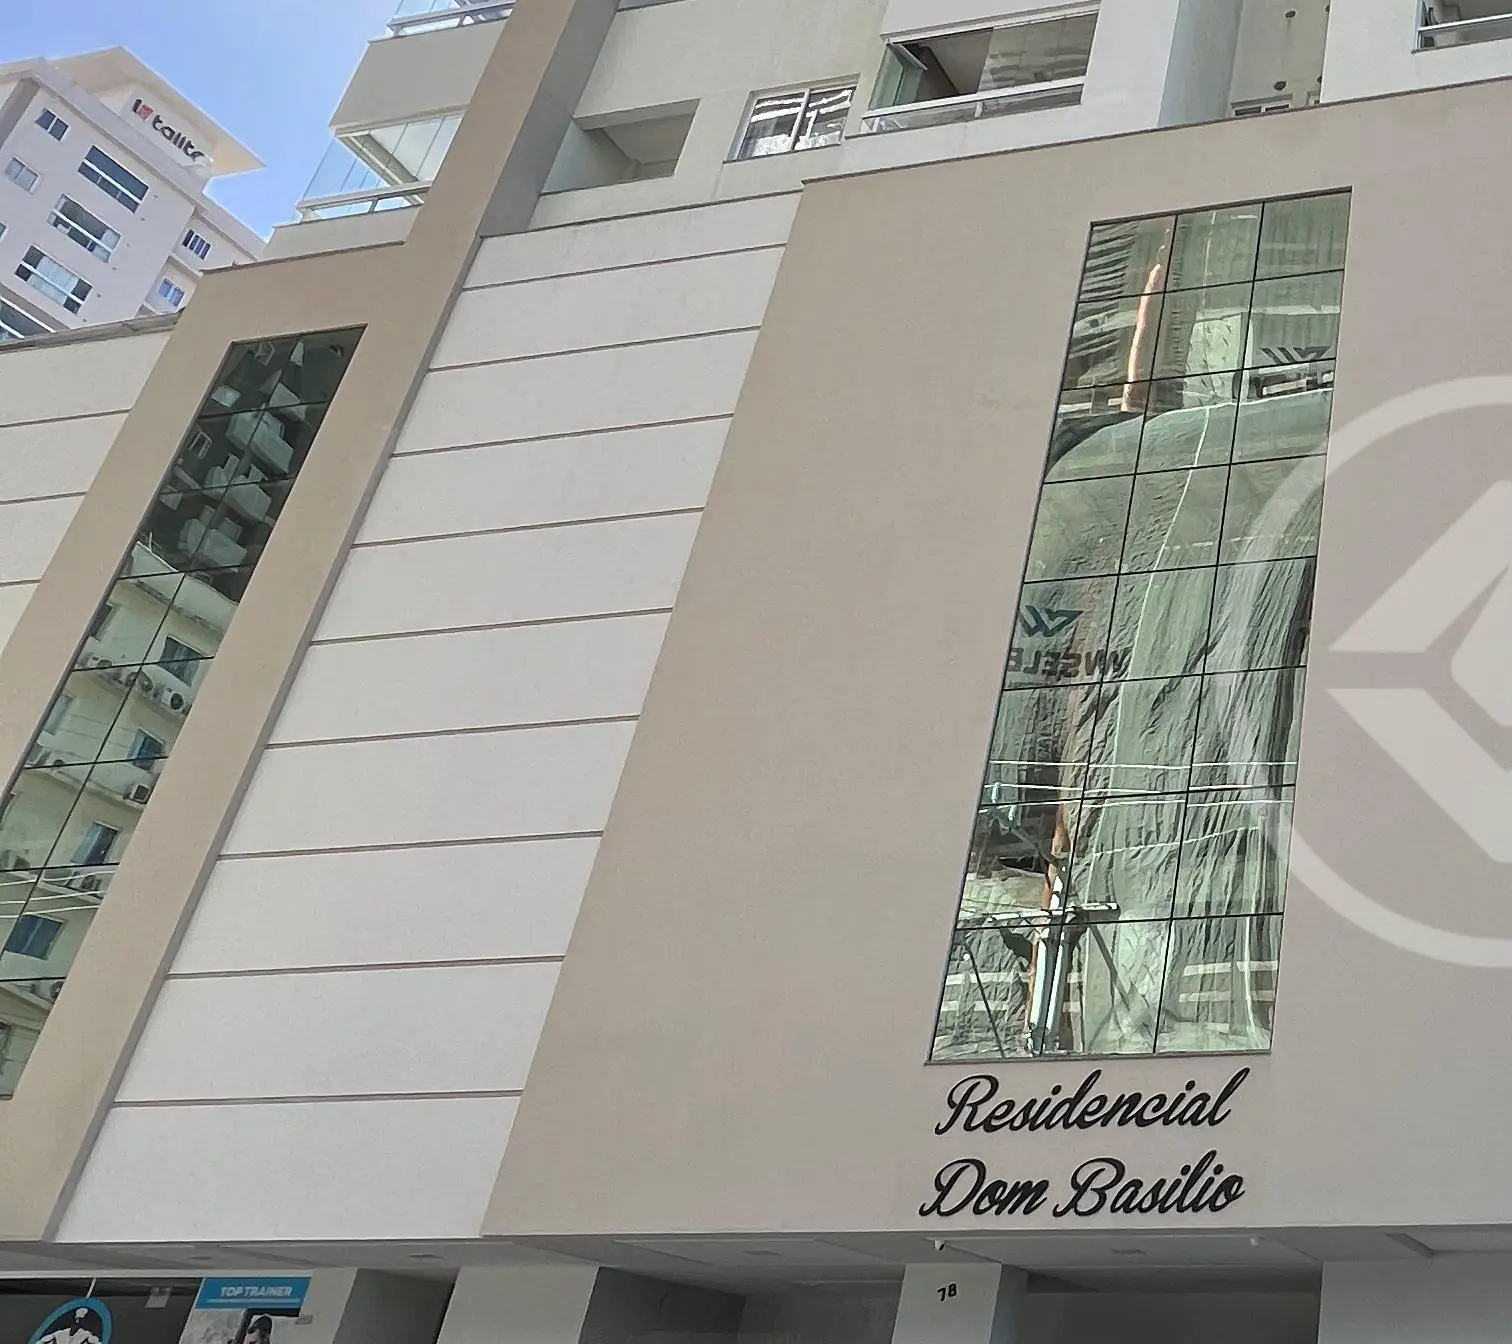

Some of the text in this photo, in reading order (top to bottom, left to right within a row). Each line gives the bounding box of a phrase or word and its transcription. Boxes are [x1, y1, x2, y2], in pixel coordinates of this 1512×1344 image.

[934, 1067, 1250, 1136] Residencial
[918, 1149, 1246, 1218] Dom Basilio
[221, 1286, 294, 1297] TOP TRAINER
[937, 1283, 957, 1302] 78
